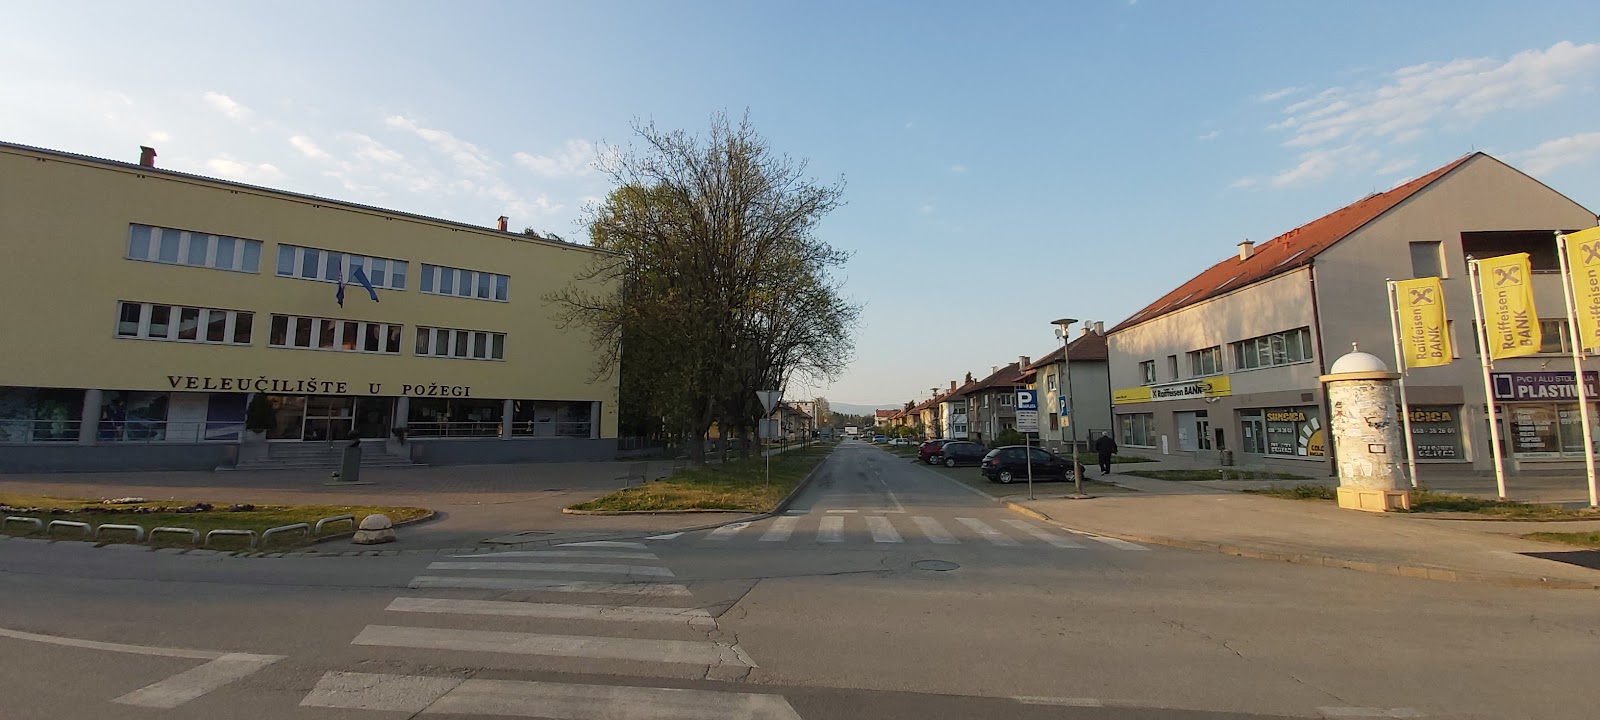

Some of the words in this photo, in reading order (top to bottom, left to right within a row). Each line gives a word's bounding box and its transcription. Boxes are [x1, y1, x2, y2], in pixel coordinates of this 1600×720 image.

[1496, 290, 1515, 350] Raiffeisen
[1513, 309, 1533, 346] BANK
[1411, 308, 1428, 360] Raiffeisen
[1427, 325, 1443, 358] BANK
[167, 376, 347, 394] VELEUČILIŠTE
[368, 383, 382, 394] U
[402, 382, 471, 397] POŽEGI
[1157, 387, 1184, 398] Raiffeisen
[1516, 375, 1533, 383] PVC
[1537, 375, 1554, 383] ALU
[1018, 392, 1032, 408] P
